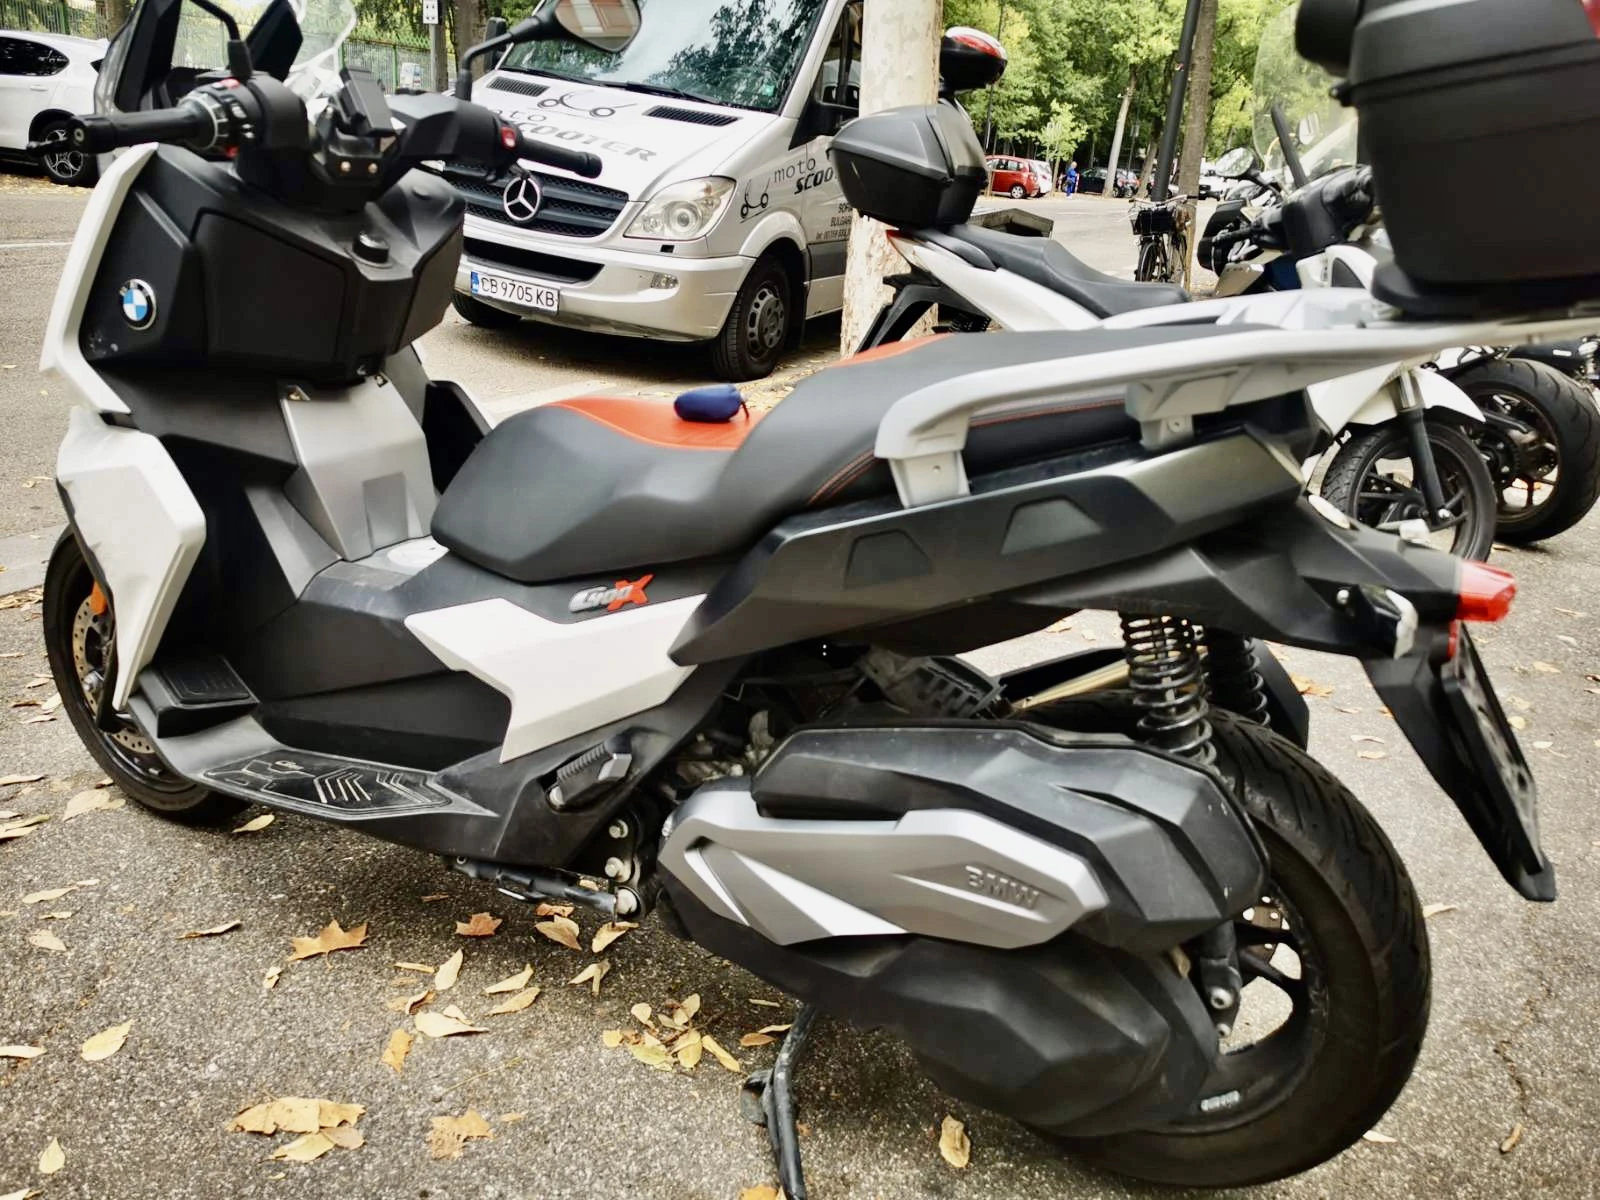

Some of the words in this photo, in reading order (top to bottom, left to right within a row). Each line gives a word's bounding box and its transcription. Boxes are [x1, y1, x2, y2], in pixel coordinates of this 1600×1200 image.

[515, 122, 657, 161] COOTER
[773, 158, 816, 184] moto
[794, 167, 837, 195] SCOO
[481, 277, 498, 294] CB
[501, 281, 533, 303] 9705
[536, 288, 555, 307] KB
[965, 865, 1040, 910] BMW
